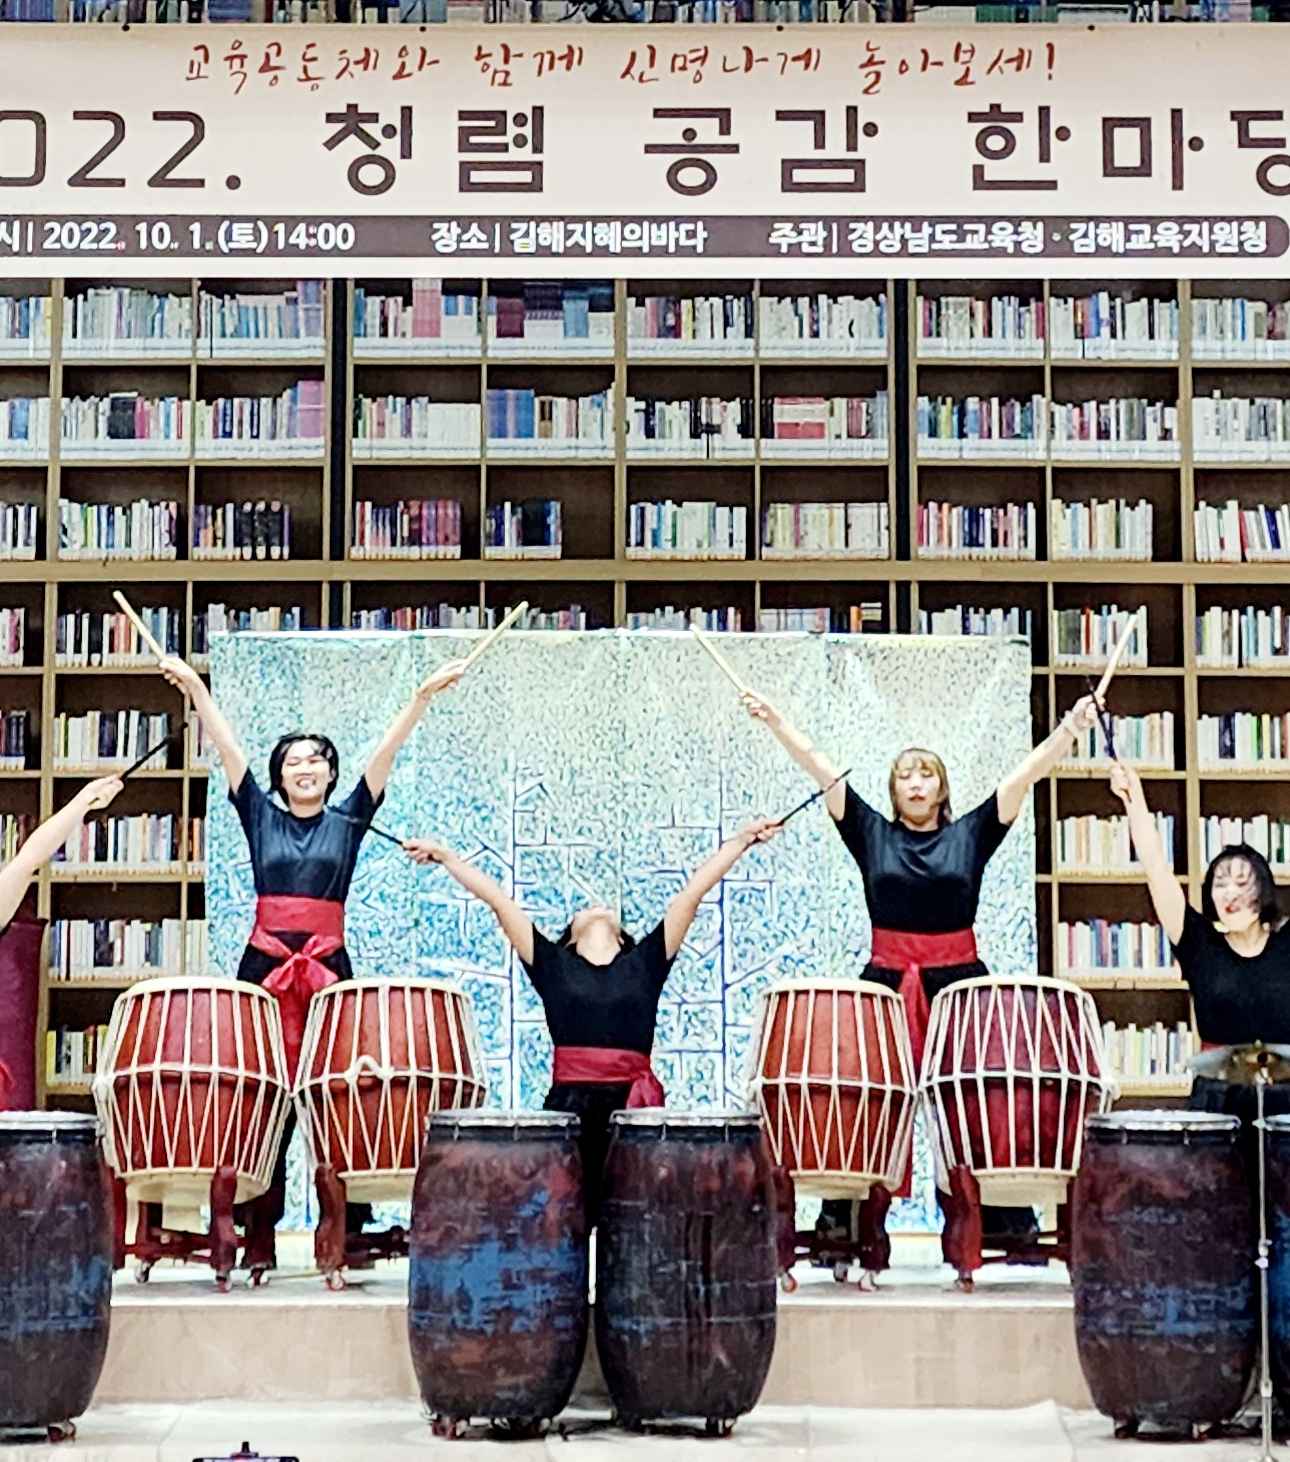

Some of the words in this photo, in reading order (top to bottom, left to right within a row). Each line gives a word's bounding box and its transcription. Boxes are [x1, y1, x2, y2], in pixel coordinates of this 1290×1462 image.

[185, 39, 440, 94] 교육공동체와
[474, 42, 584, 88] 함께
[620, 43, 821, 84] 신명나게
[859, 40, 1055, 95] 놀아보세!
[322, 103, 545, 196] 청렴
[643, 105, 879, 196] 공감
